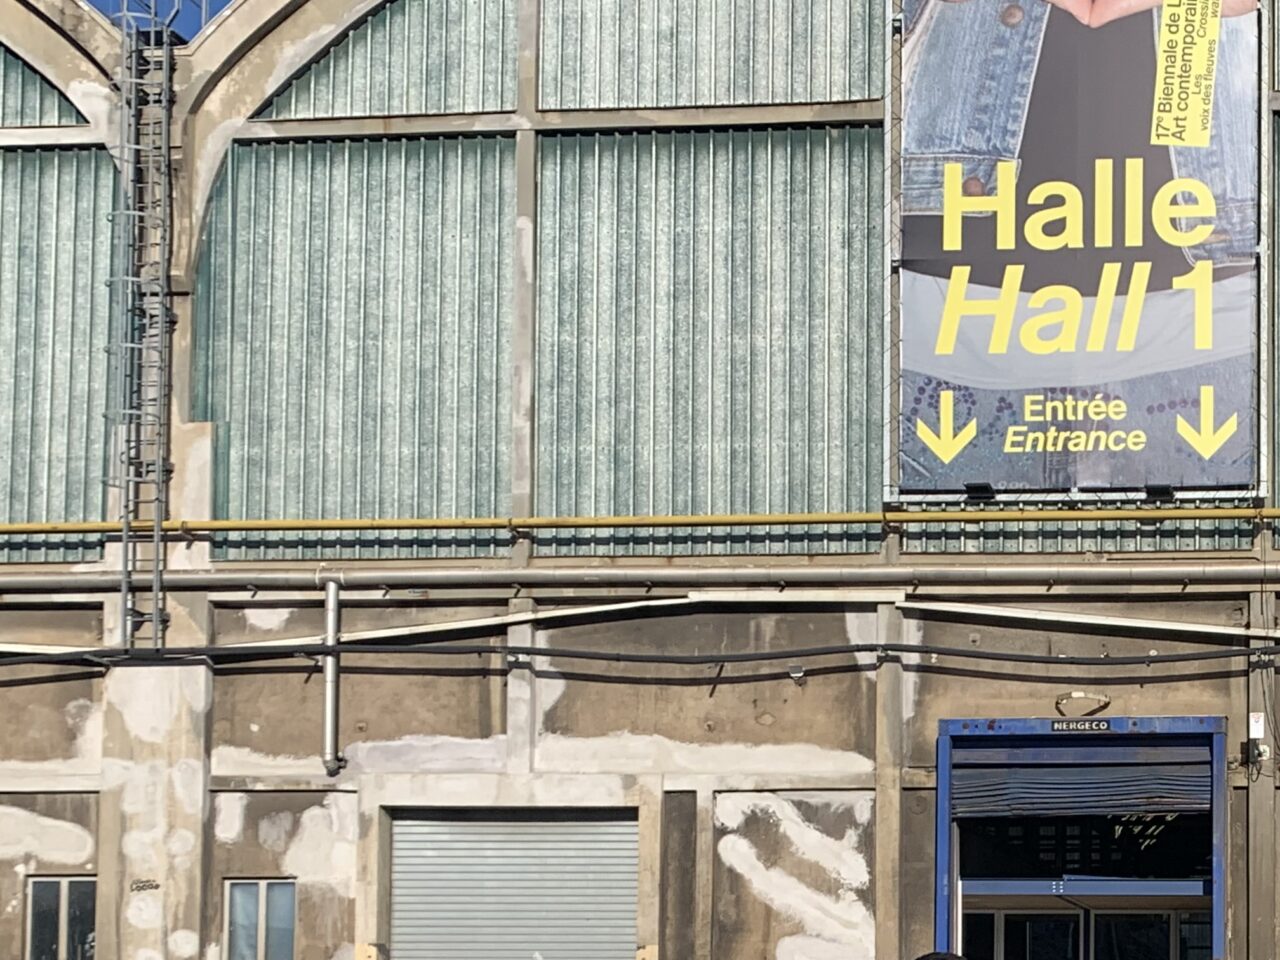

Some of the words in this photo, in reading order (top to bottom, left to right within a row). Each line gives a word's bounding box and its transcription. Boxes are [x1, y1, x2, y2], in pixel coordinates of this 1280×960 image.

[1196, 0, 1209, 38] Crossi
[1210, 0, 1220, 18] wa
[1164, 12, 1181, 35] de
[1177, 0, 1197, 112] contemporai
[1202, 39, 1217, 81] fleuves
[1157, 39, 1179, 113] Biennale
[1191, 73, 1203, 95] Les
[1201, 84, 1212, 105] des
[1171, 115, 1188, 141] Art
[1199, 107, 1210, 131] voix
[943, 158, 1217, 250] Halle
[934, 261, 1152, 355] Hall
[1172, 259, 1213, 350] 1
[1024, 393, 1127, 422] Entrée
[1003, 425, 1147, 453] Entrance
[1053, 721, 1108, 730] NERGECO
